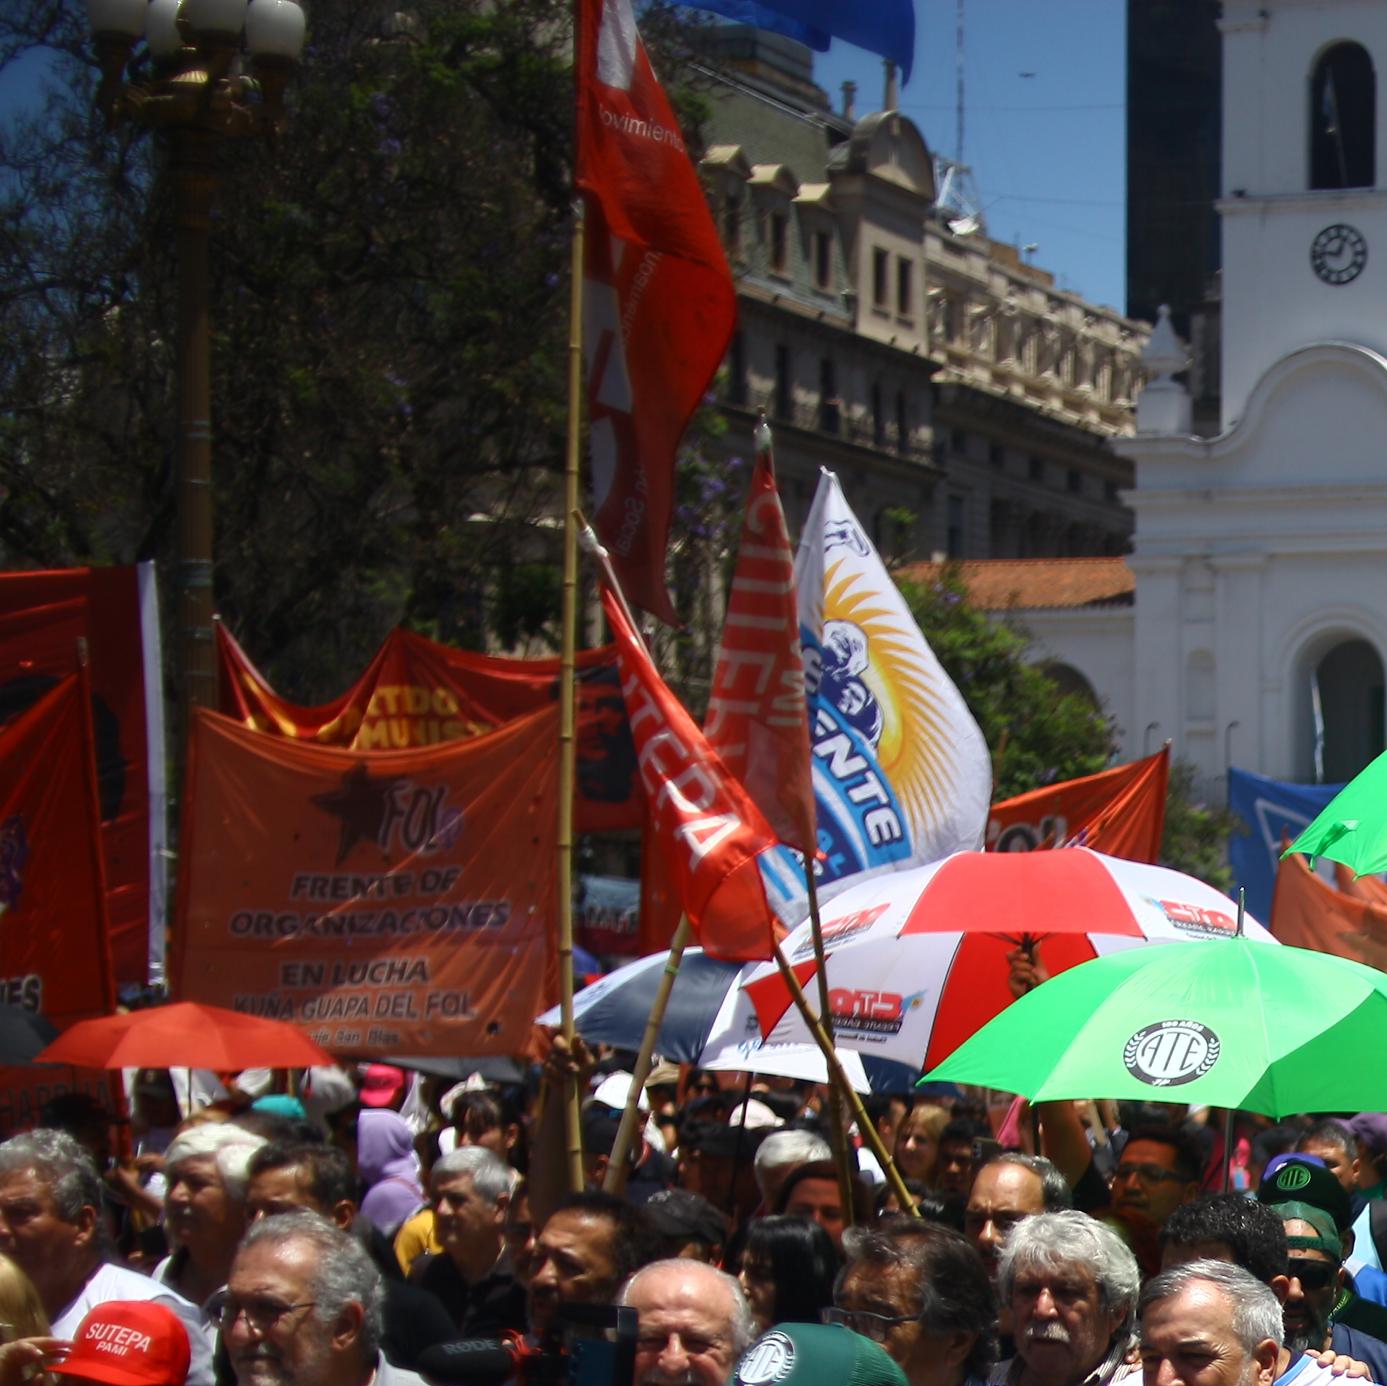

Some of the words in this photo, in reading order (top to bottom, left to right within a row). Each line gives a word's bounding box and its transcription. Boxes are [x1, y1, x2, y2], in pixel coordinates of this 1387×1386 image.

[382, 780, 449, 853] FOL
[290, 869, 415, 901] FRENTE
[419, 866, 462, 897] DE
[280, 961, 324, 988] EN
[331, 956, 431, 987] LUCHA
[300, 992, 371, 1021] GUAPA
[372, 993, 420, 1020] DEL
[424, 991, 478, 1020] FOL
[1141, 1031, 1201, 1072] ATE
[86, 1322, 152, 1353] SUTEPA
[96, 1341, 128, 1356] PAMI
